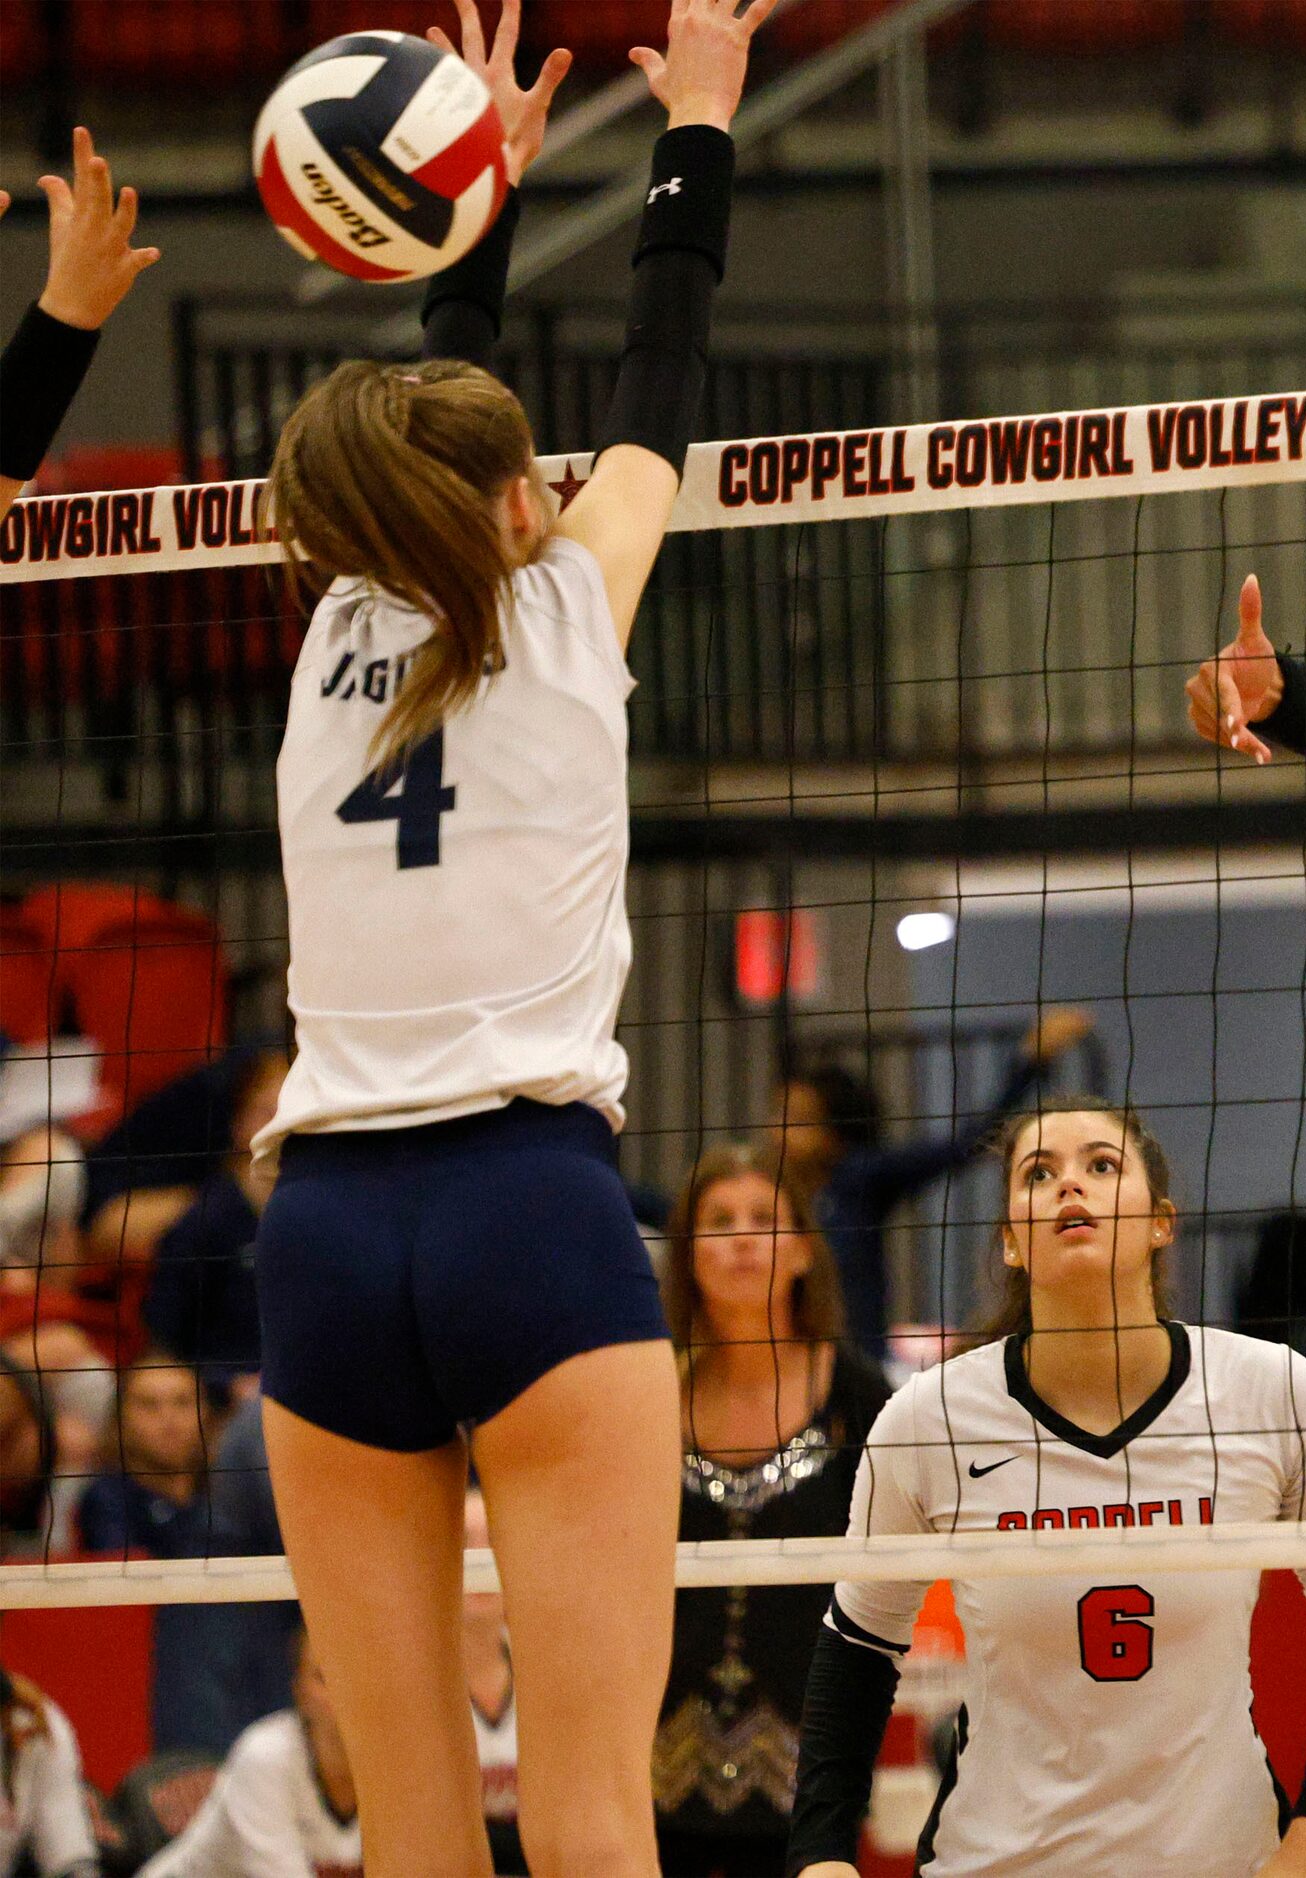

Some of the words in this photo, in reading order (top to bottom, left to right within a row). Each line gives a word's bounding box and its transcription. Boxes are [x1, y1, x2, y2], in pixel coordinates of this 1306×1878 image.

[302, 162, 391, 248] Baden
[718, 430, 915, 508] COPPELL
[926, 412, 1134, 490] COWGIRL
[173, 483, 280, 550] VOLL
[335, 724, 456, 871] 4
[1077, 1584, 1155, 1682] 6
